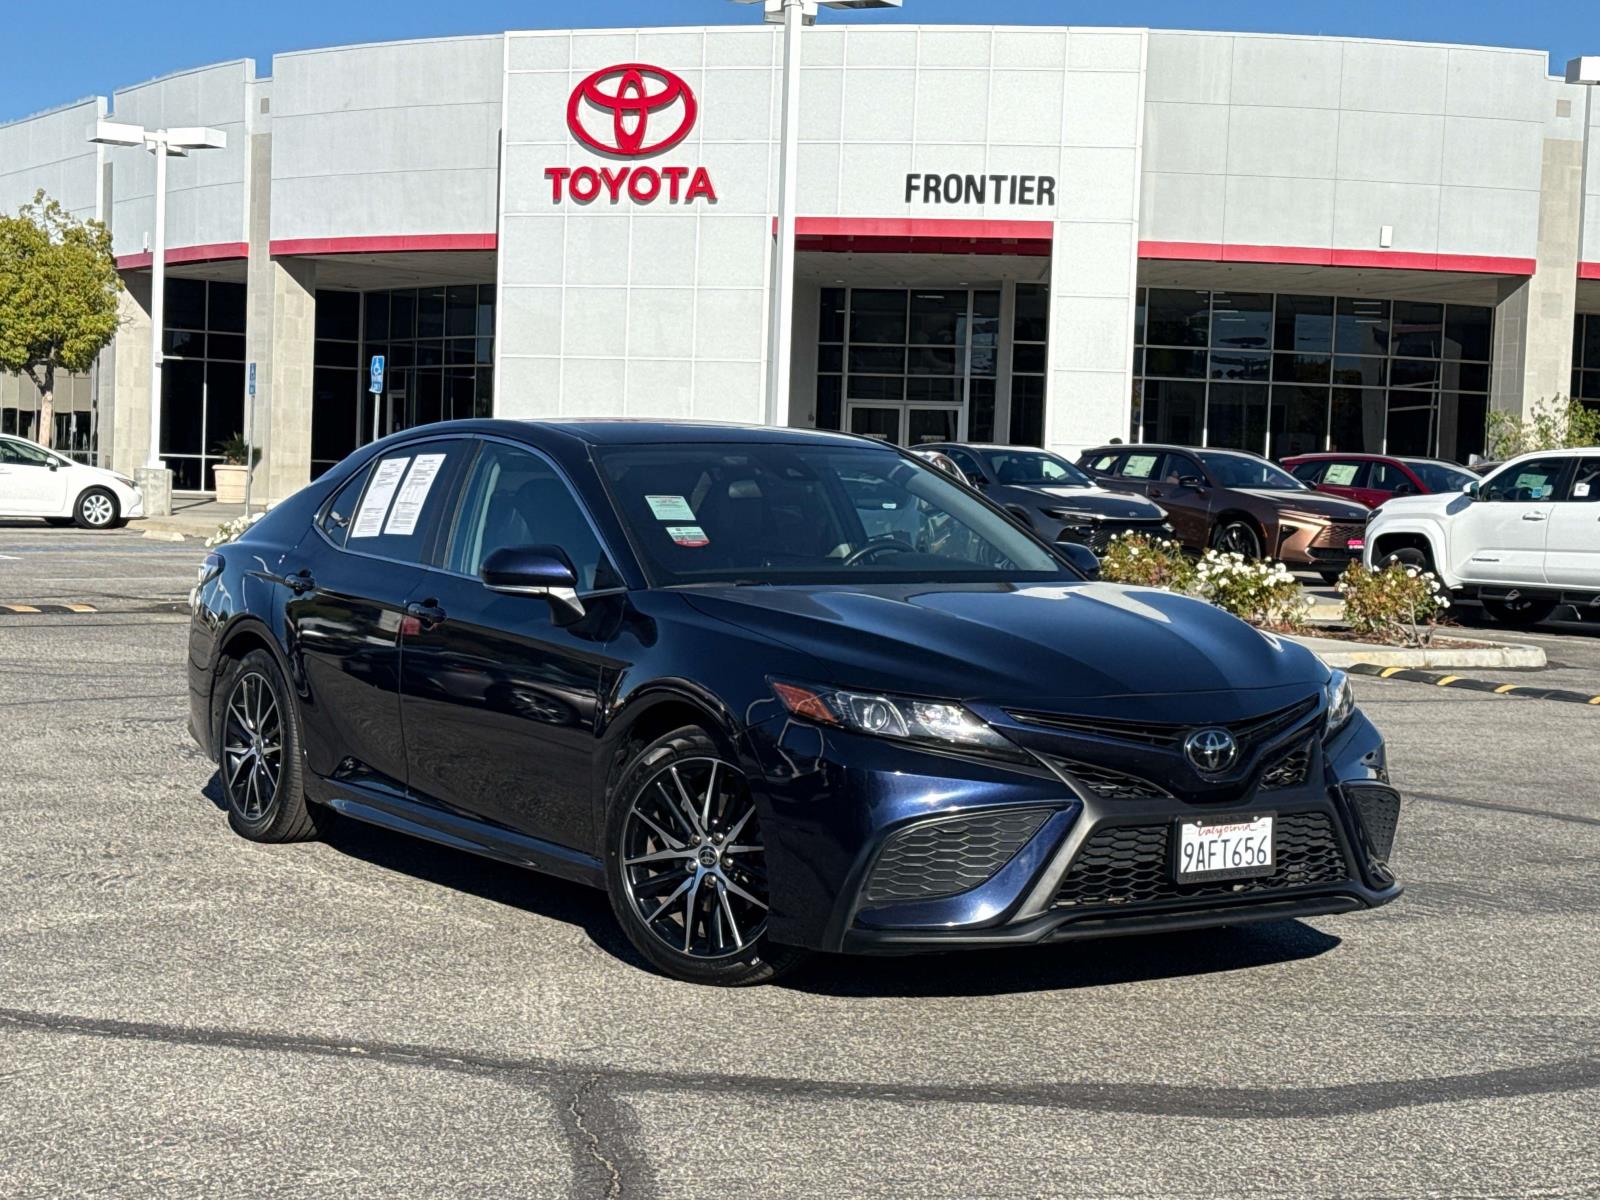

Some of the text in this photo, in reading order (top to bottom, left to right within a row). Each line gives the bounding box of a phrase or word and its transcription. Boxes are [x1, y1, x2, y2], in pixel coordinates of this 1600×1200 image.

[544, 166, 717, 204] TOYOTA
[905, 173, 1056, 206] FRONTIER
[1183, 835, 1268, 873] 9AFT656
